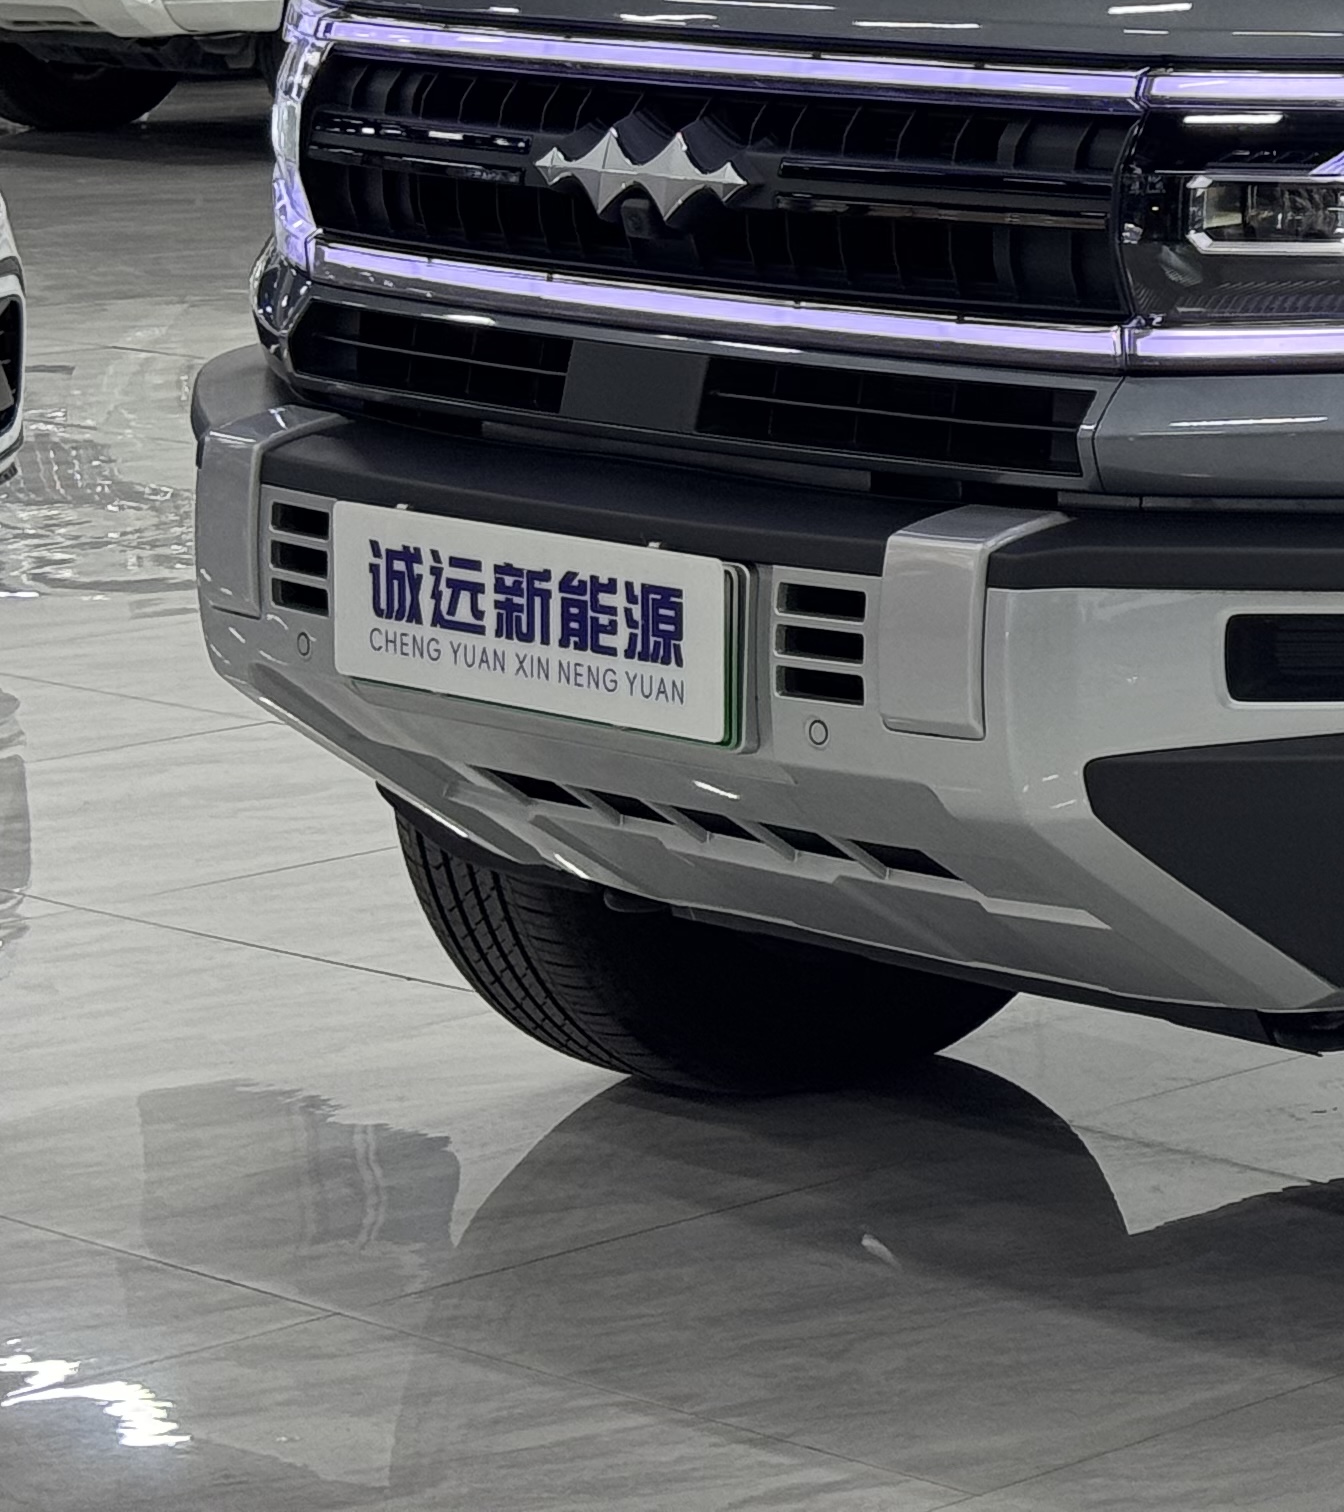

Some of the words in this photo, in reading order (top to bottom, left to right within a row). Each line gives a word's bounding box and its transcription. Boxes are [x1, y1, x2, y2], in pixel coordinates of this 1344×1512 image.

[368, 539, 685, 669] 诚远新能源
[369, 627, 442, 662] CHENG
[449, 639, 507, 674] YUAN
[514, 652, 550, 682] XIN
[557, 660, 618, 693] NENG
[624, 671, 686, 705] YUAN
